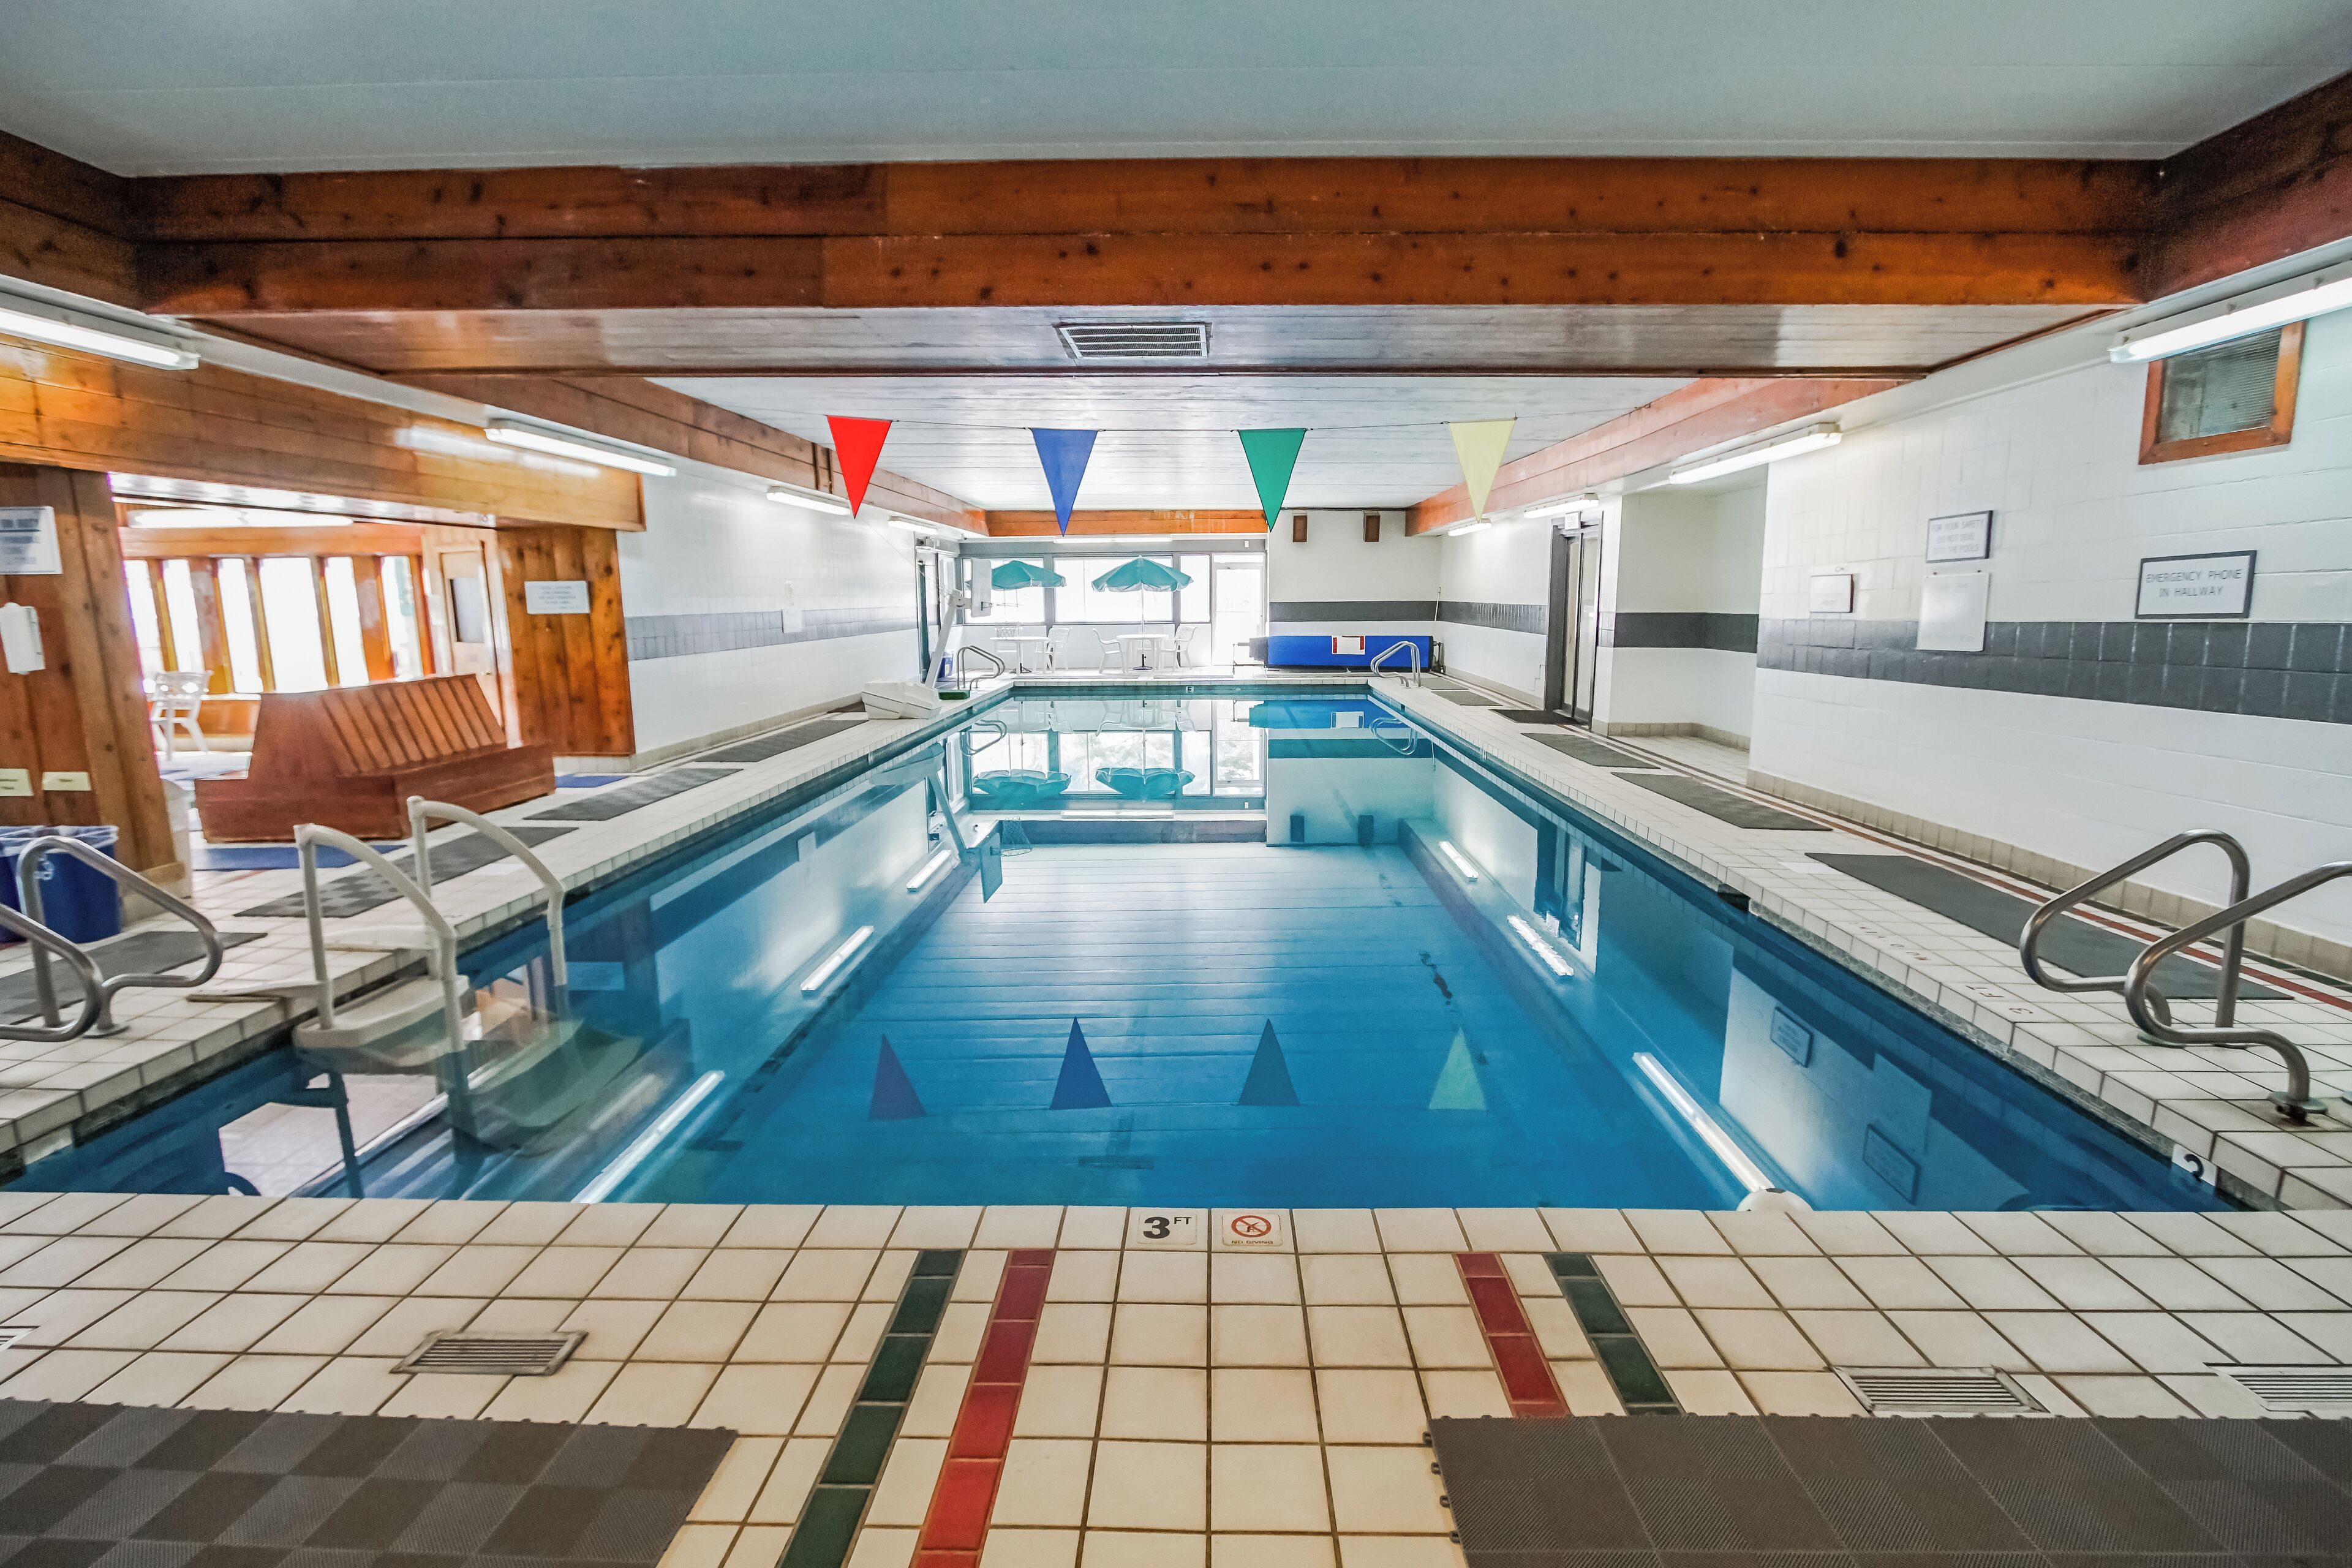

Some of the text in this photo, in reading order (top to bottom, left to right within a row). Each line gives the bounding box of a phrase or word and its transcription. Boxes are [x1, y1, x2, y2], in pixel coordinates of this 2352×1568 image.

[2146, 569, 2242, 582] EMERGENCY PHONE
[2158, 586, 2225, 598] IN HALLWAY
[1143, 1216, 1193, 1239] 3 FT
